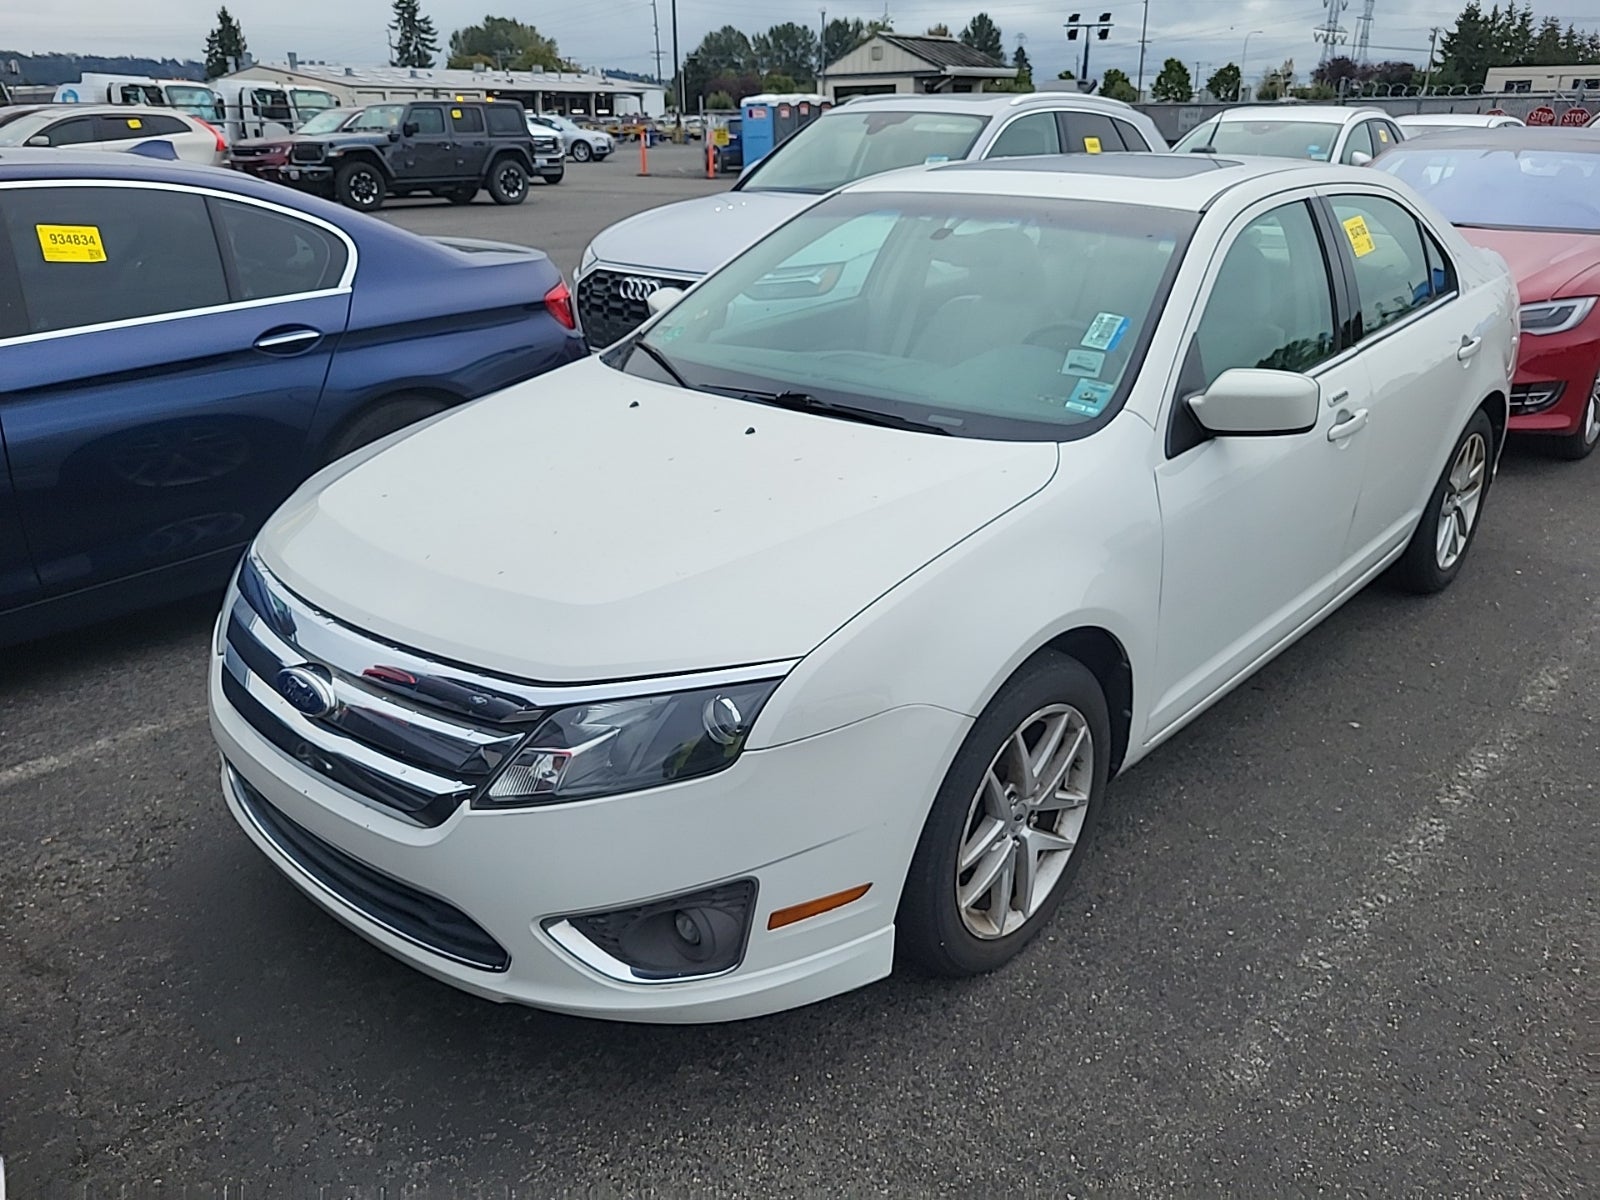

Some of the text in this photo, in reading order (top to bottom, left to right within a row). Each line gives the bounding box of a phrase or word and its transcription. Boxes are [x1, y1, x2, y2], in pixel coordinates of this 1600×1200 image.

[1530, 110, 1554, 122] STOP
[1563, 112, 1588, 123] STOP
[49, 233, 96, 246] 934834
